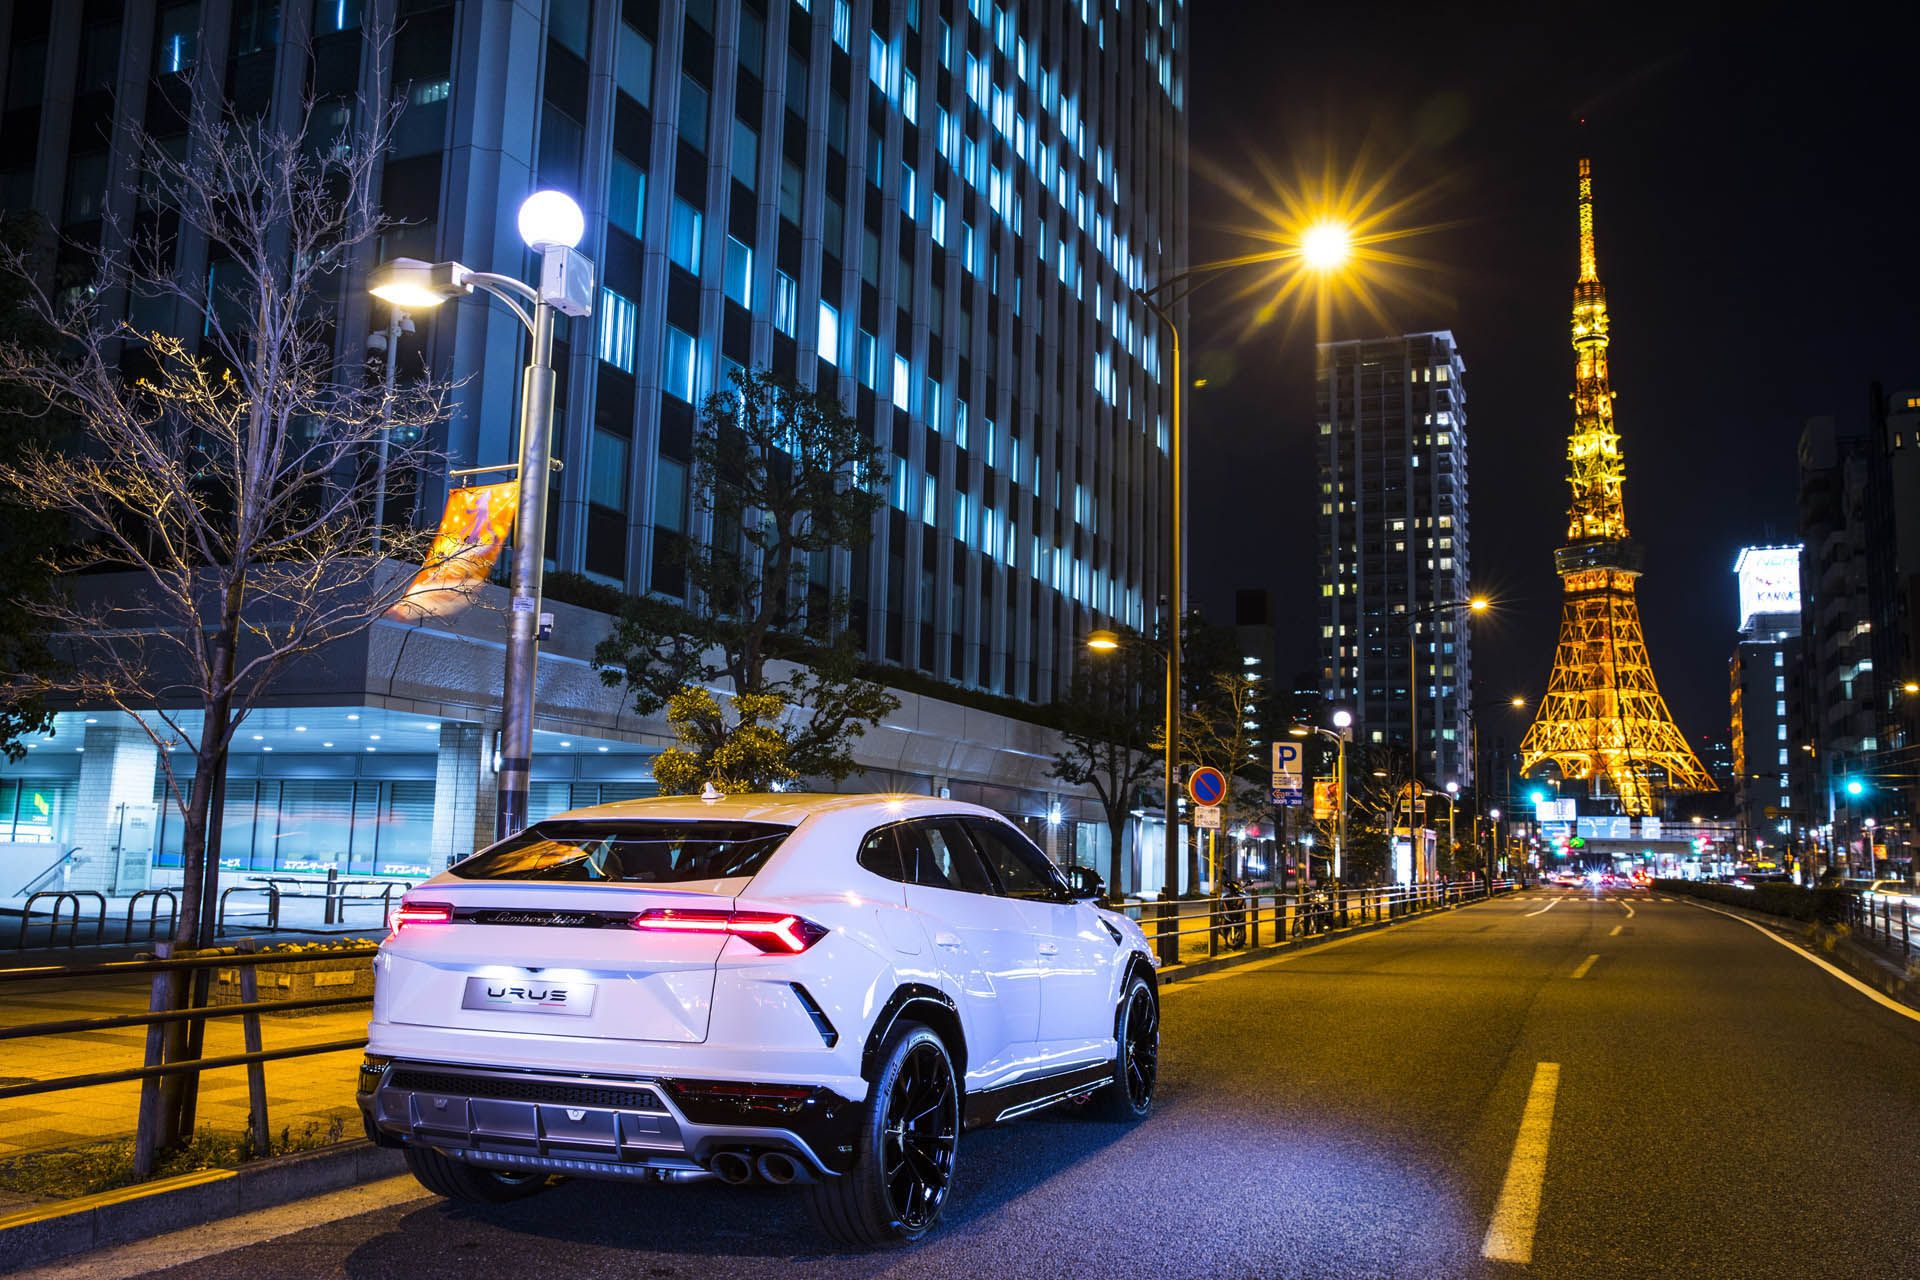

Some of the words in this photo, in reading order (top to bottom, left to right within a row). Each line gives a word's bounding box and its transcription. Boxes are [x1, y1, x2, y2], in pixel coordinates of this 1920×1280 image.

[1279, 746, 1297, 769] P
[488, 911, 586, 925] Lamborghini
[488, 987, 568, 1001] URUS
